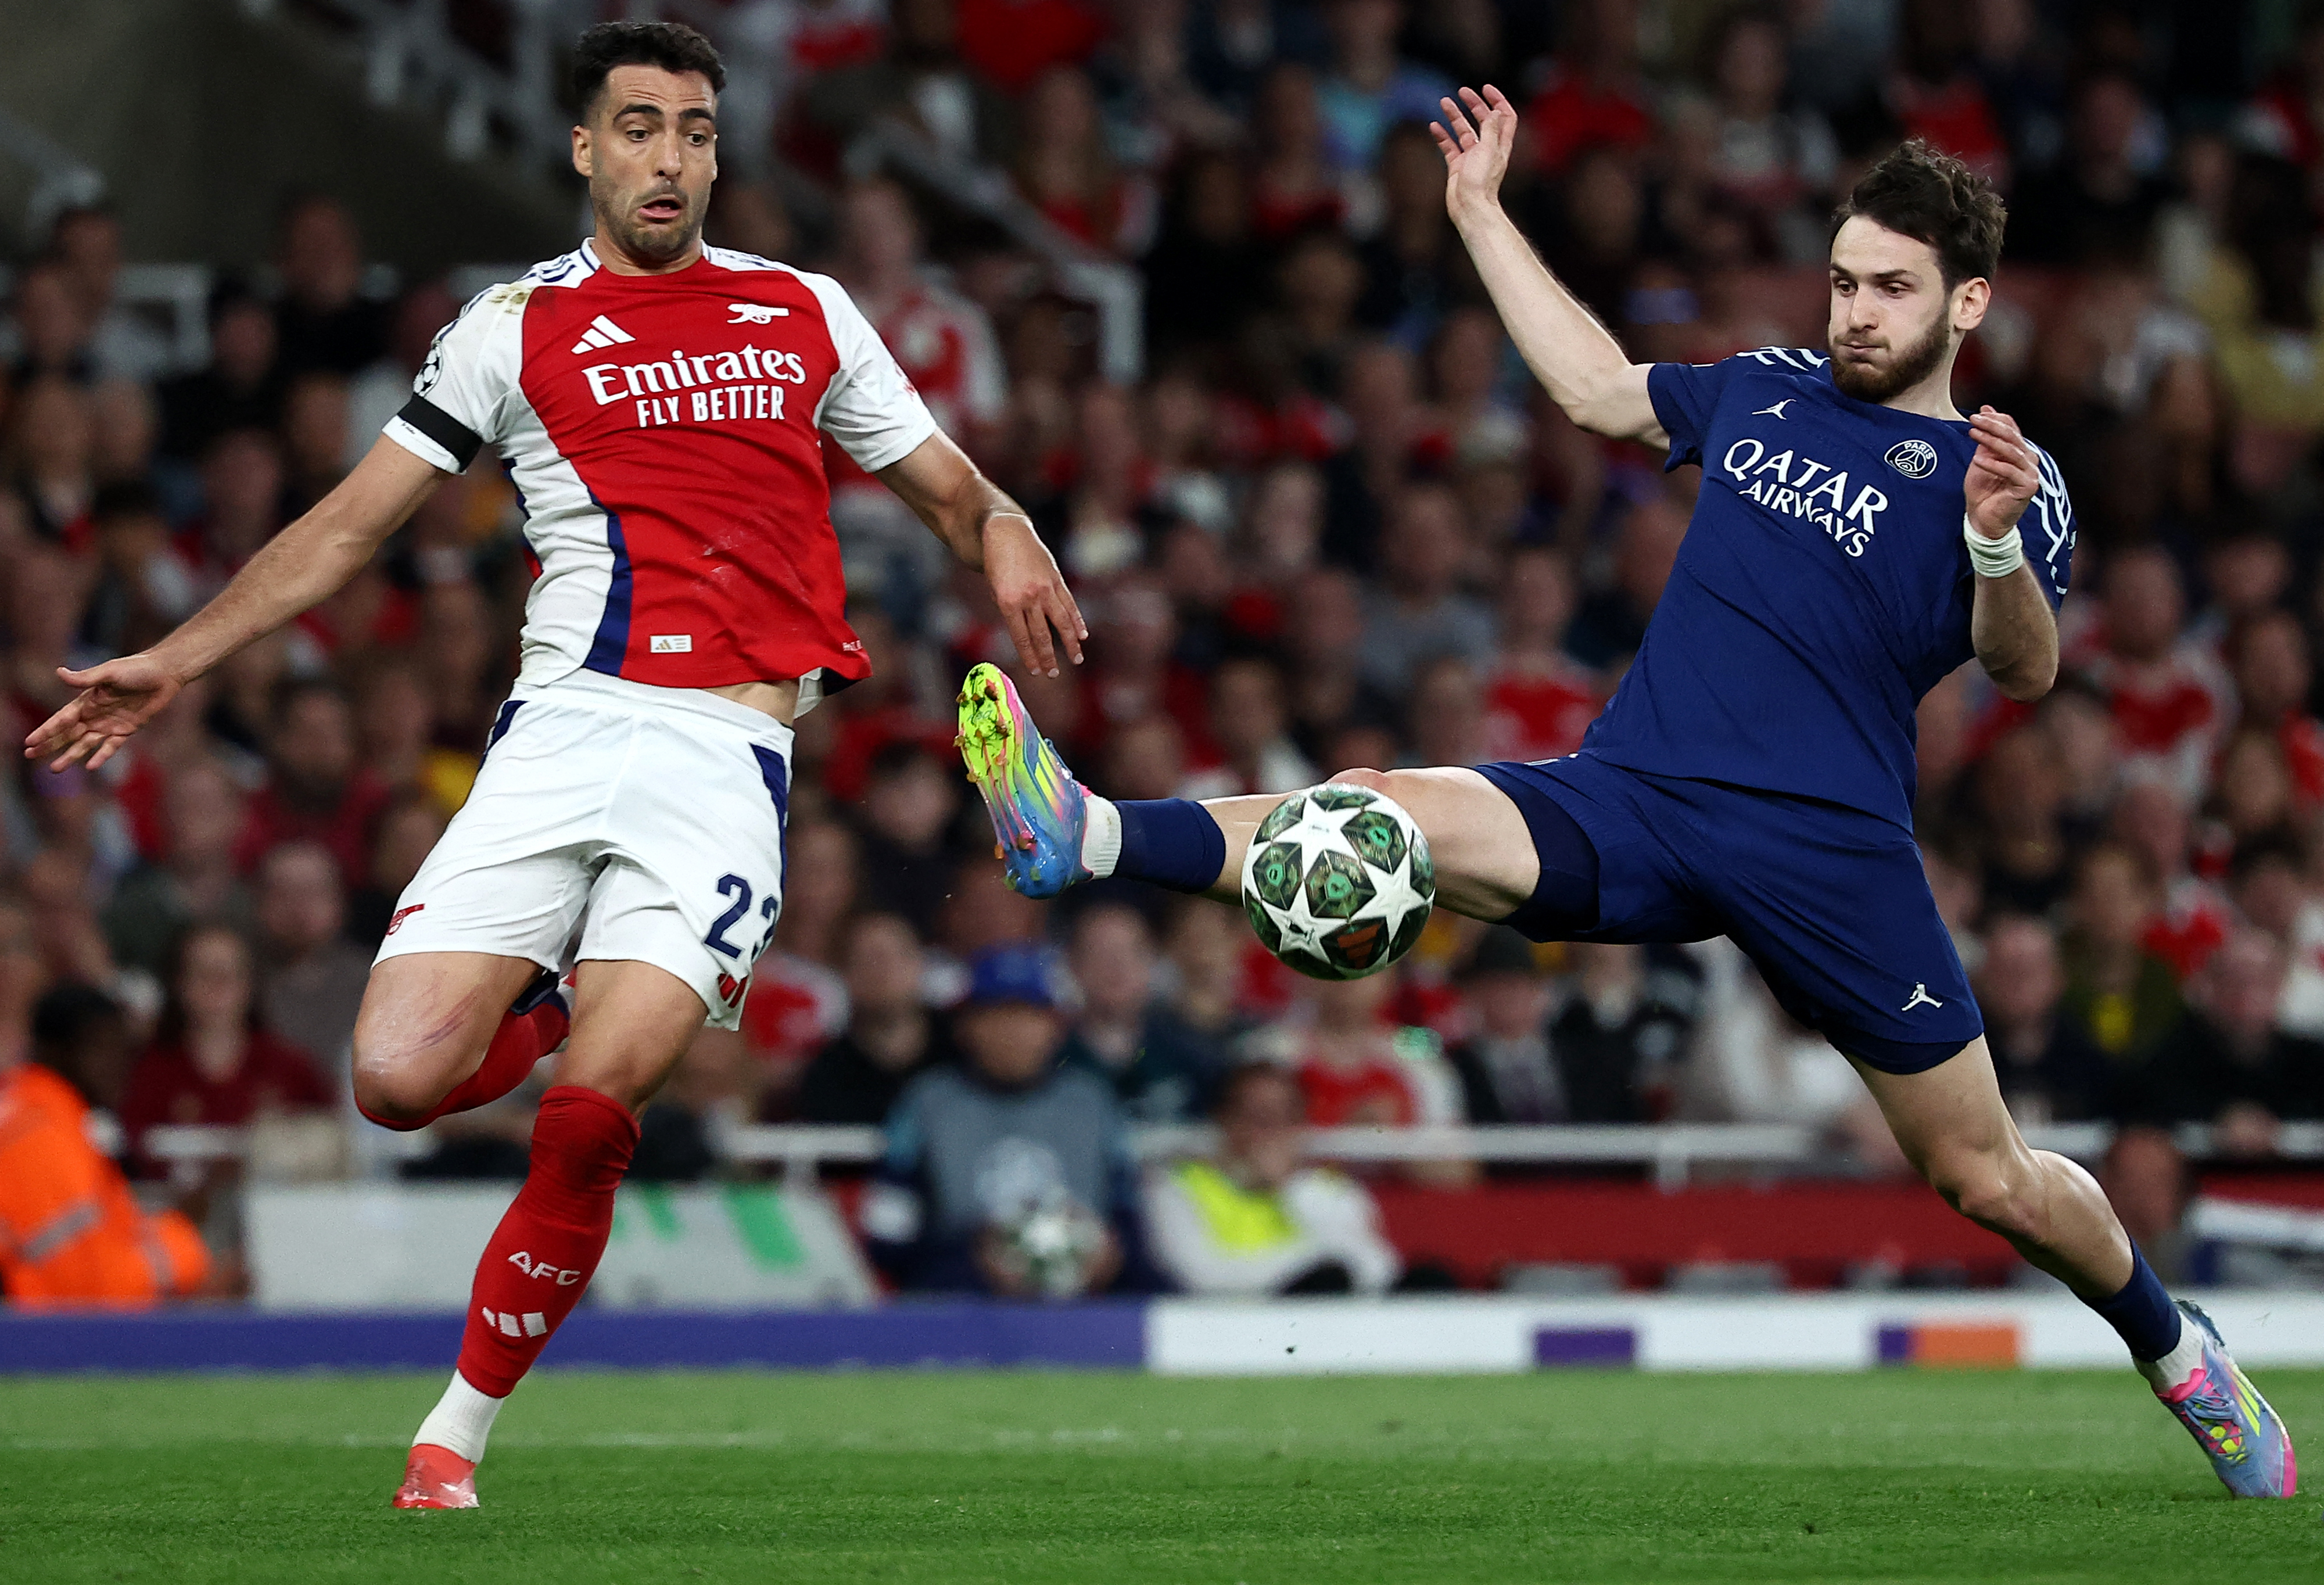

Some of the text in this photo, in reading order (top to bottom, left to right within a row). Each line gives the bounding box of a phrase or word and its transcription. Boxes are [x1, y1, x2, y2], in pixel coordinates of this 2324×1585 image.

[581, 343, 806, 406] Emirates
[636, 385, 785, 427] FLY BETTER
[1904, 442, 1934, 460] PARIS
[1723, 438, 1888, 535] QATAR
[1738, 480, 1870, 557] AIRWAYS
[508, 1251, 580, 1286] AFC
